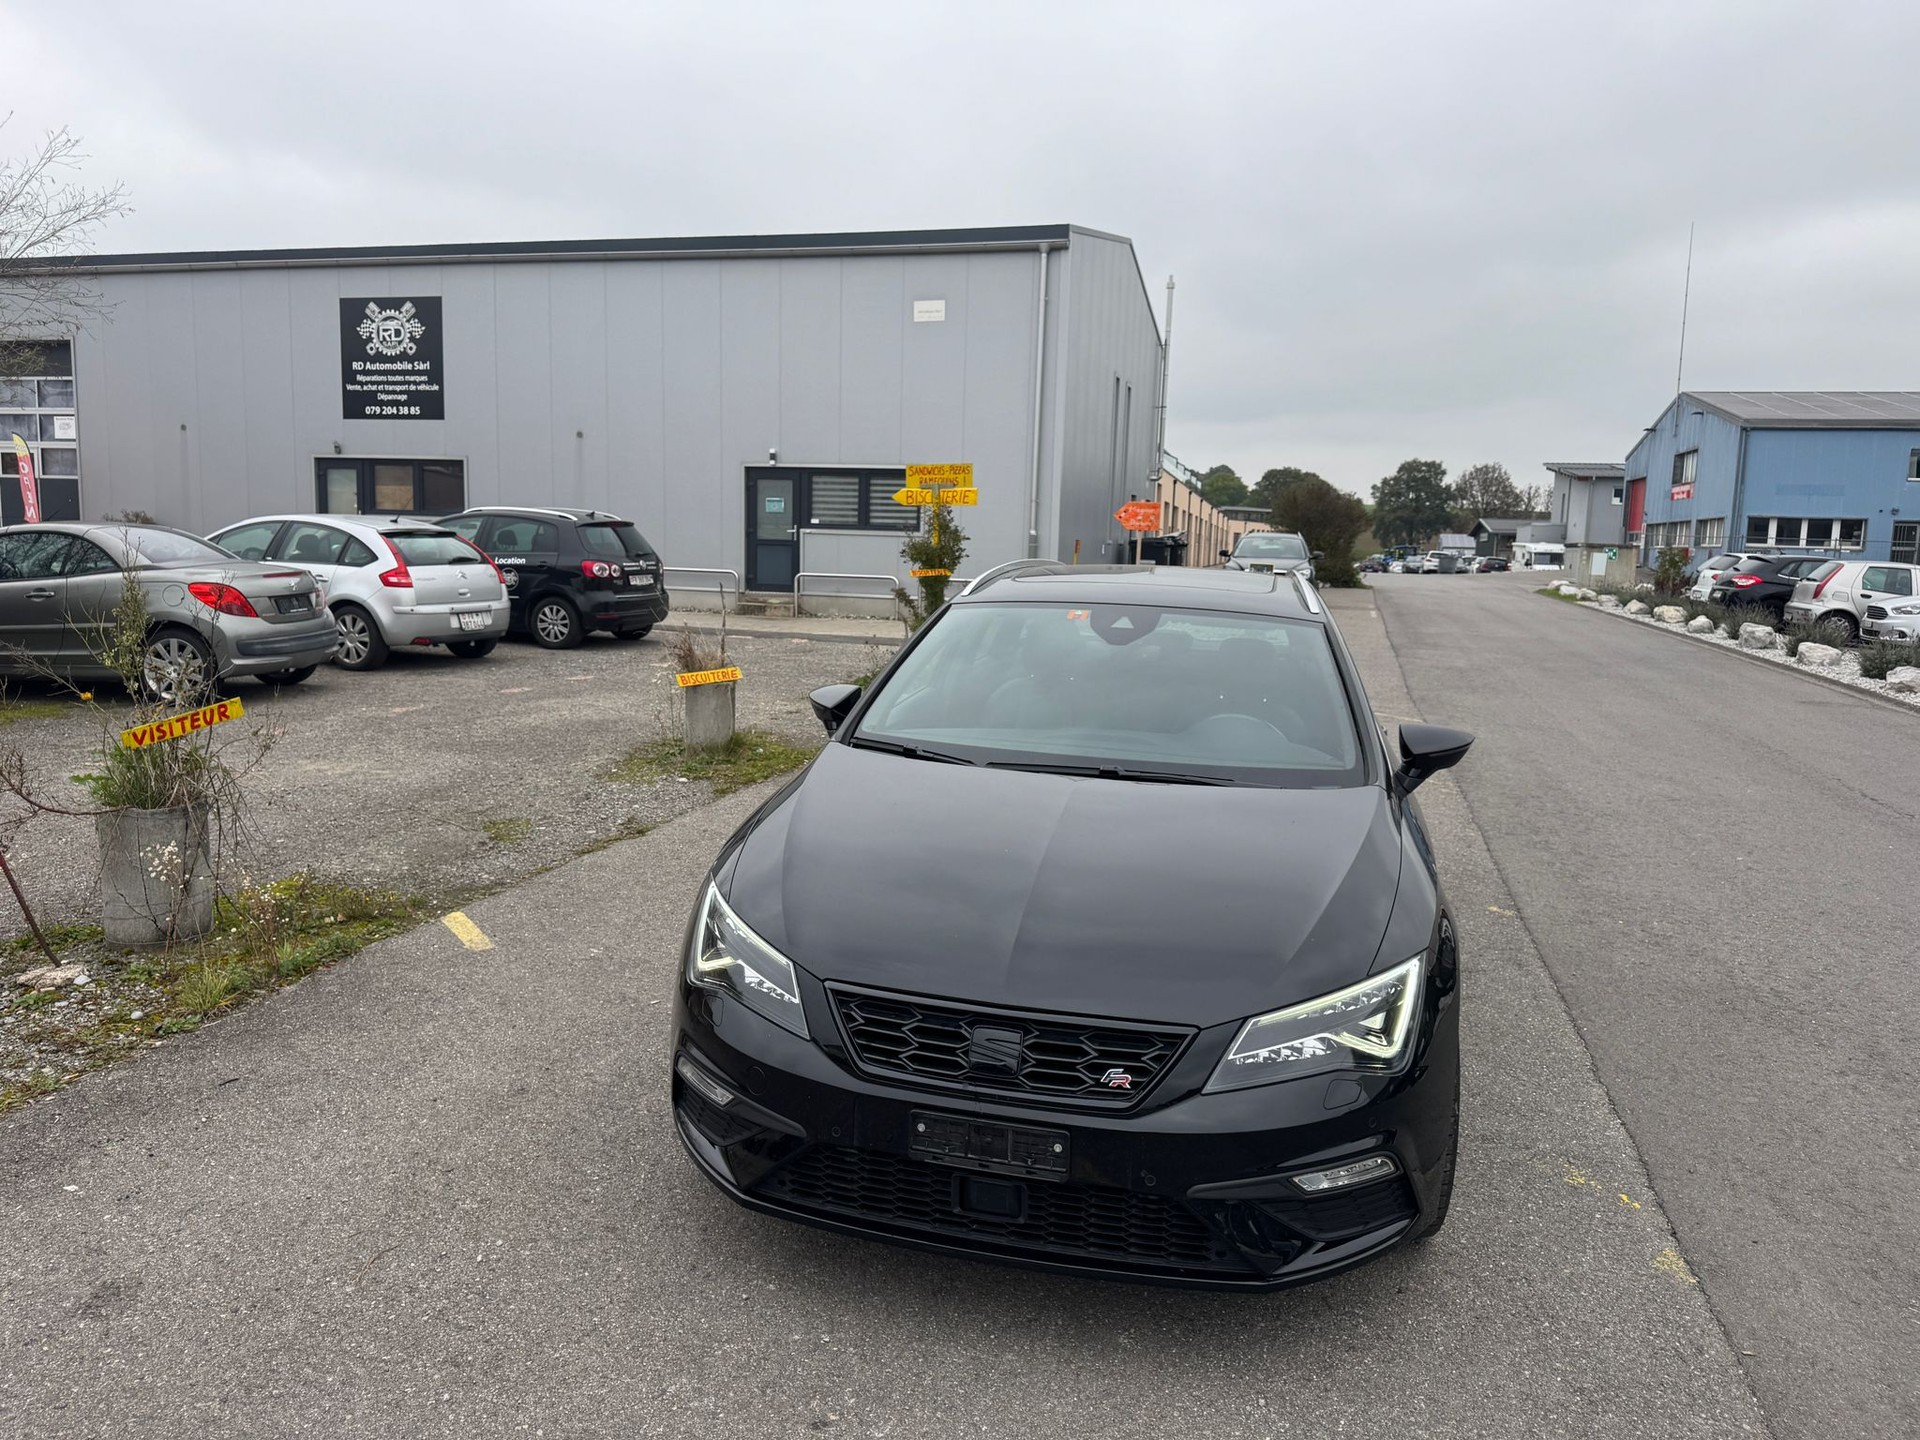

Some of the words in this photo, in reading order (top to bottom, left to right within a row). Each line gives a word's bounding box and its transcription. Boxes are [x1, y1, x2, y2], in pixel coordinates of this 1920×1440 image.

[379, 326, 404, 341] RD
[352, 361, 364, 370] RD
[365, 361, 413, 370] Automobile
[356, 374, 387, 382] Réparations
[377, 393, 408, 402] Dépannage
[365, 406, 381, 415] 079
[382, 406, 397, 415] 204
[398, 406, 409, 415] 38
[409, 406, 420, 415] 85
[906, 489, 972, 505] BISCTERIE
[495, 556, 526, 564] Location
[680, 669, 739, 686] BISCUITERIE
[131, 703, 231, 746] VISITEUR
